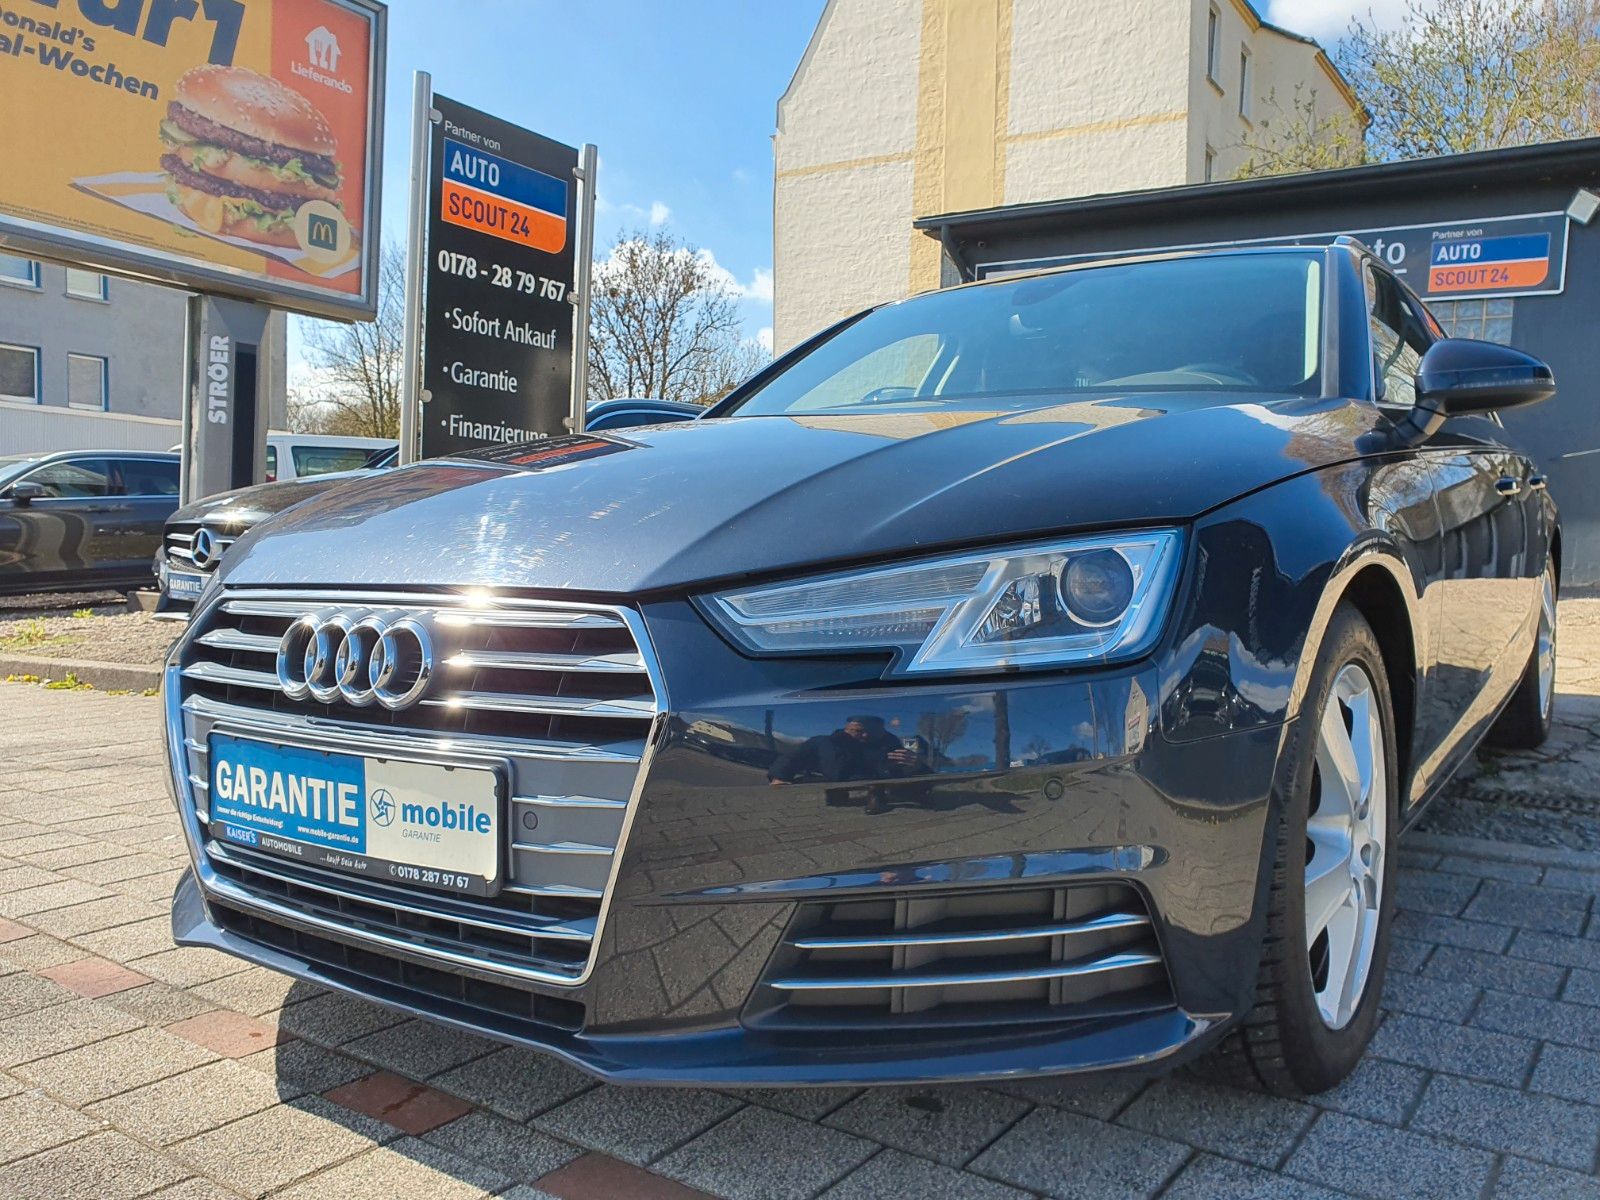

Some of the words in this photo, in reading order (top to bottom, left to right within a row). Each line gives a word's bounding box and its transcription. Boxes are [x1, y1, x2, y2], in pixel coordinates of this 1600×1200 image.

[0, 5, 95, 52] onald's
[291, 61, 353, 94] Lieferando
[444, 120, 481, 143] Partner
[483, 137, 501, 151] von
[451, 150, 500, 187] AUTO
[449, 192, 508, 230] SCOUT
[511, 211, 530, 237] 24
[1432, 230, 1465, 240] Partner
[1467, 228, 1483, 236] von
[1367, 238, 1406, 265] to
[1436, 243, 1481, 262] AUTO
[438, 249, 477, 279] 0178
[491, 264, 513, 288] 28
[516, 270, 535, 294] 79
[538, 277, 566, 302] 767
[1435, 269, 1487, 286] SCOUT
[1490, 267, 1509, 282] 24
[452, 307, 501, 338] Sofort
[503, 319, 557, 350] Ankauf
[207, 335, 230, 425] STRÖER
[451, 361, 518, 393] Garantie
[170, 579, 202, 592] GARANTIE
[215, 760, 359, 827] GARANTIE
[402, 801, 491, 834] mobile
[261, 837, 302, 855] AUTOMOBILE
[401, 829, 442, 843] GARANTIE
[398, 865, 420, 880] 0178
[422, 869, 440, 884] 287
[442, 873, 454, 887] 97
[456, 876, 470, 889] 67
